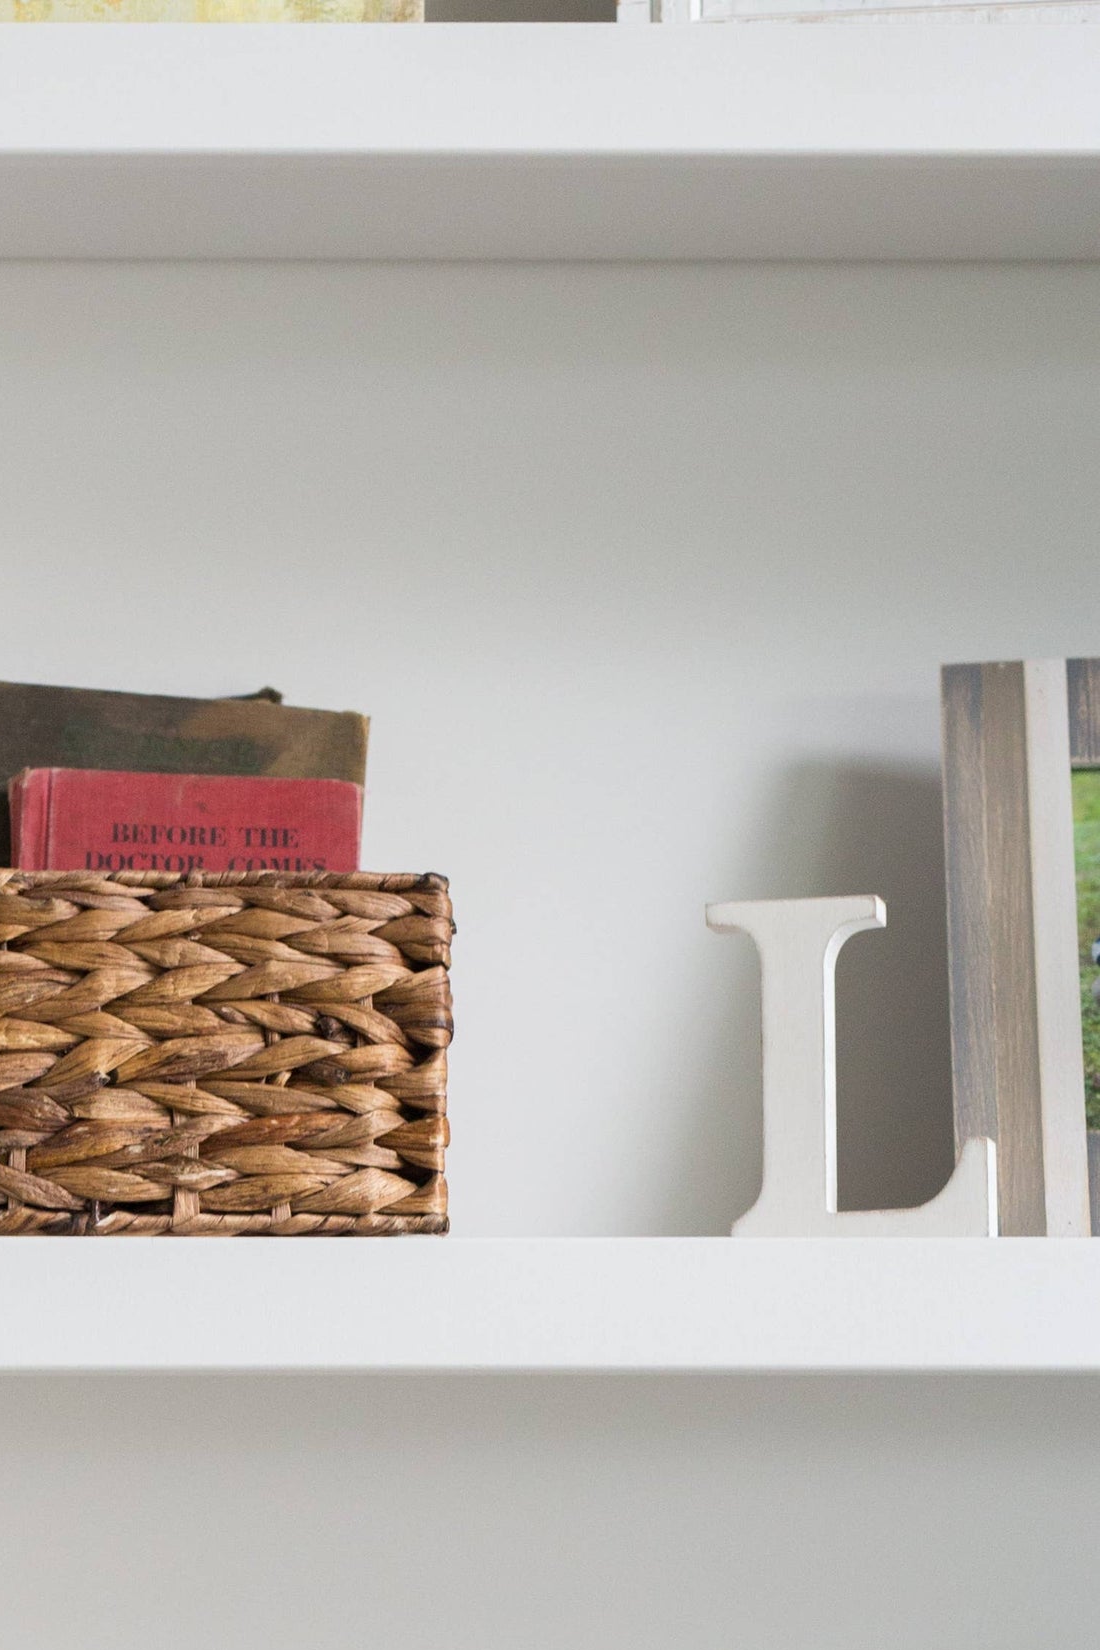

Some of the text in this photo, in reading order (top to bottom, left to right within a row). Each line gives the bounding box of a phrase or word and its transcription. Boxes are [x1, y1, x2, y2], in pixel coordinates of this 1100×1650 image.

[111, 822, 299, 848] BEFORE THE
[84, 850, 205, 871] DOCTOR
[705, 894, 999, 1238] L
